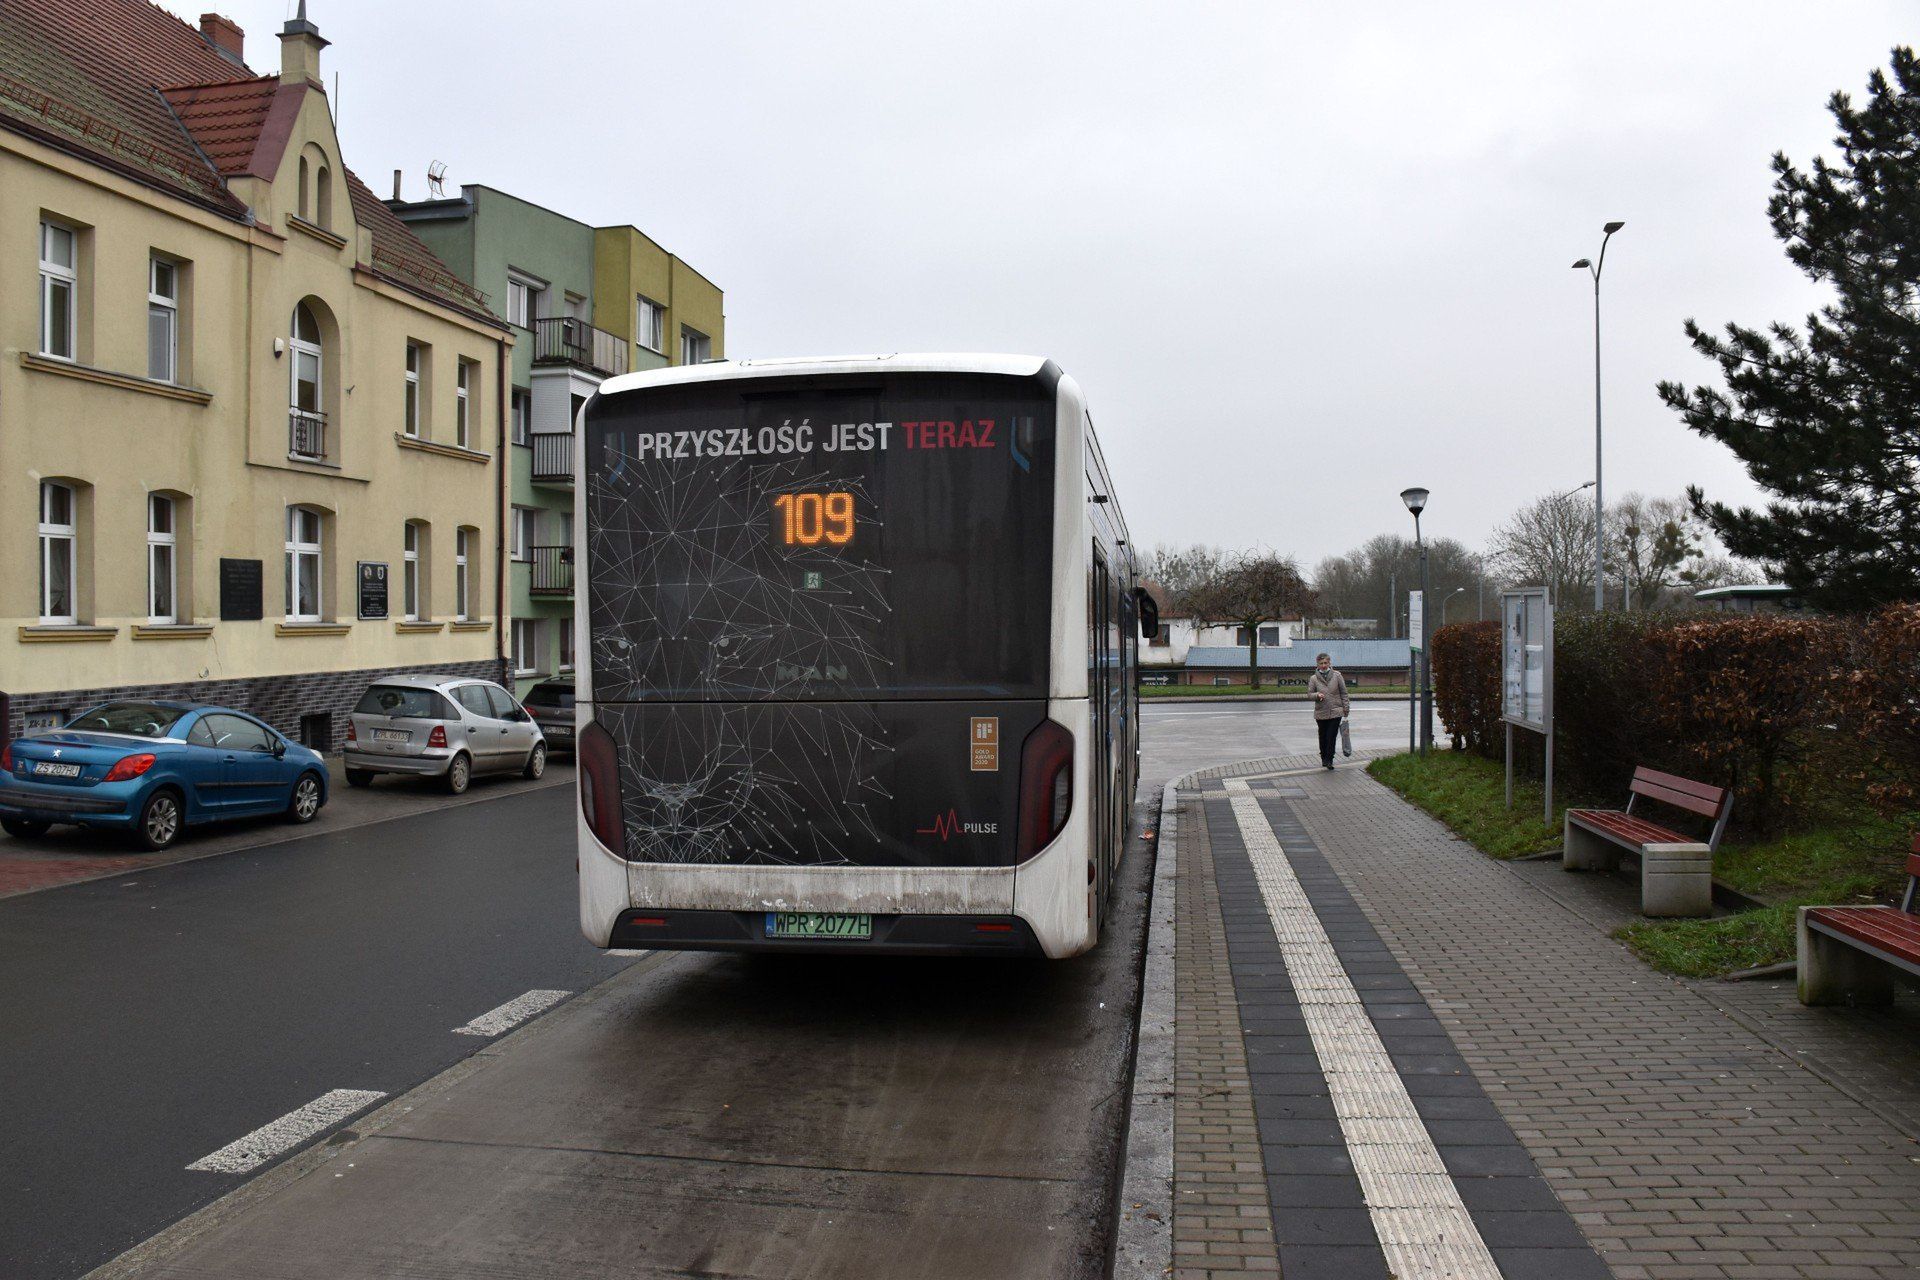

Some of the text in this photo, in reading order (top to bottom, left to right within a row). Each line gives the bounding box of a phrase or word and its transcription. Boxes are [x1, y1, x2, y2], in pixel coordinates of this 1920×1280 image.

[638, 419, 996, 460] PRZYSZŁOŚĆ JEST TERAZ
[775, 493, 853, 544] 109
[777, 665, 848, 680] MAN
[36, 763, 50, 774] ZS
[964, 822, 998, 834] PULSE
[775, 914, 809, 933] WPR
[814, 914, 870, 935] 2077H
